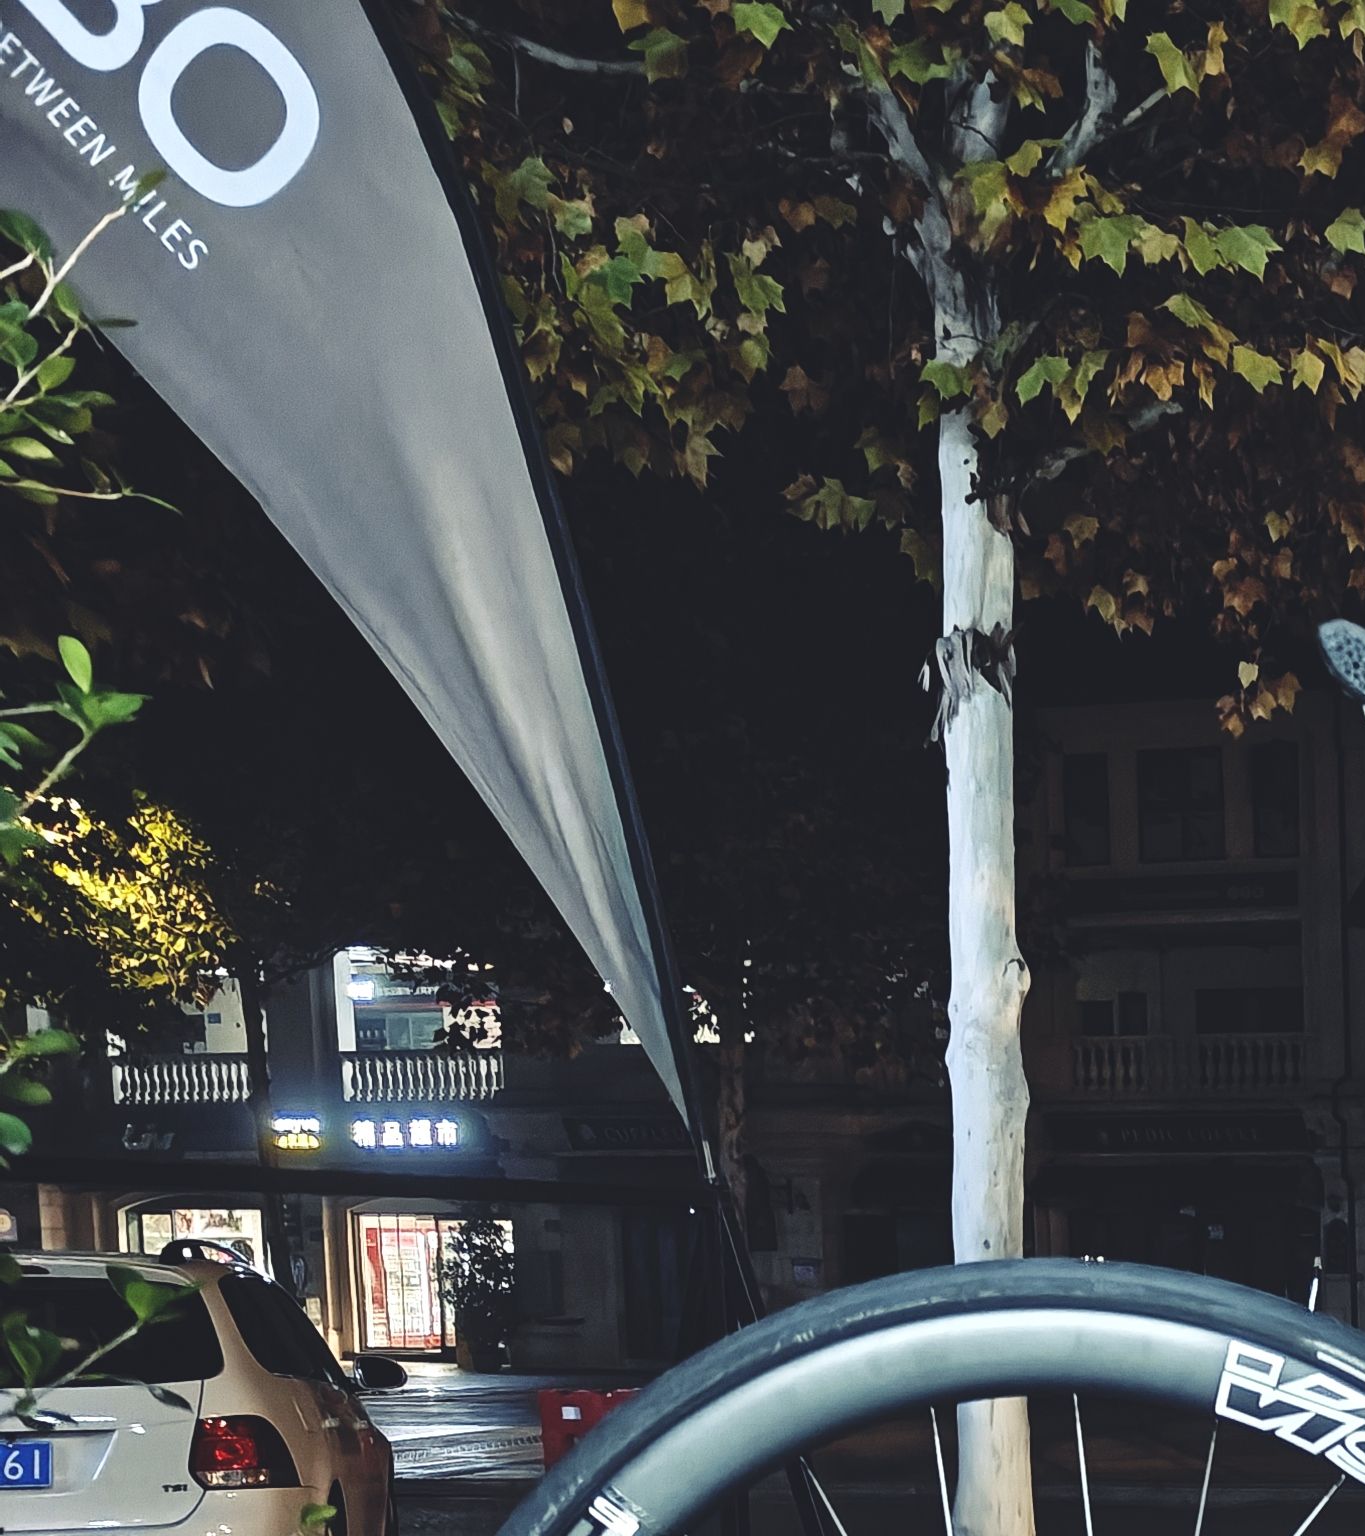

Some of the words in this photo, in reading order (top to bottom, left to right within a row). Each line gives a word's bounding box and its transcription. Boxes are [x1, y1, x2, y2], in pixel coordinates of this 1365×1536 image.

[0, 20, 116, 166] ETWEEN
[109, 164, 209, 270] MILES
[4, 1449, 40, 1480] 61
